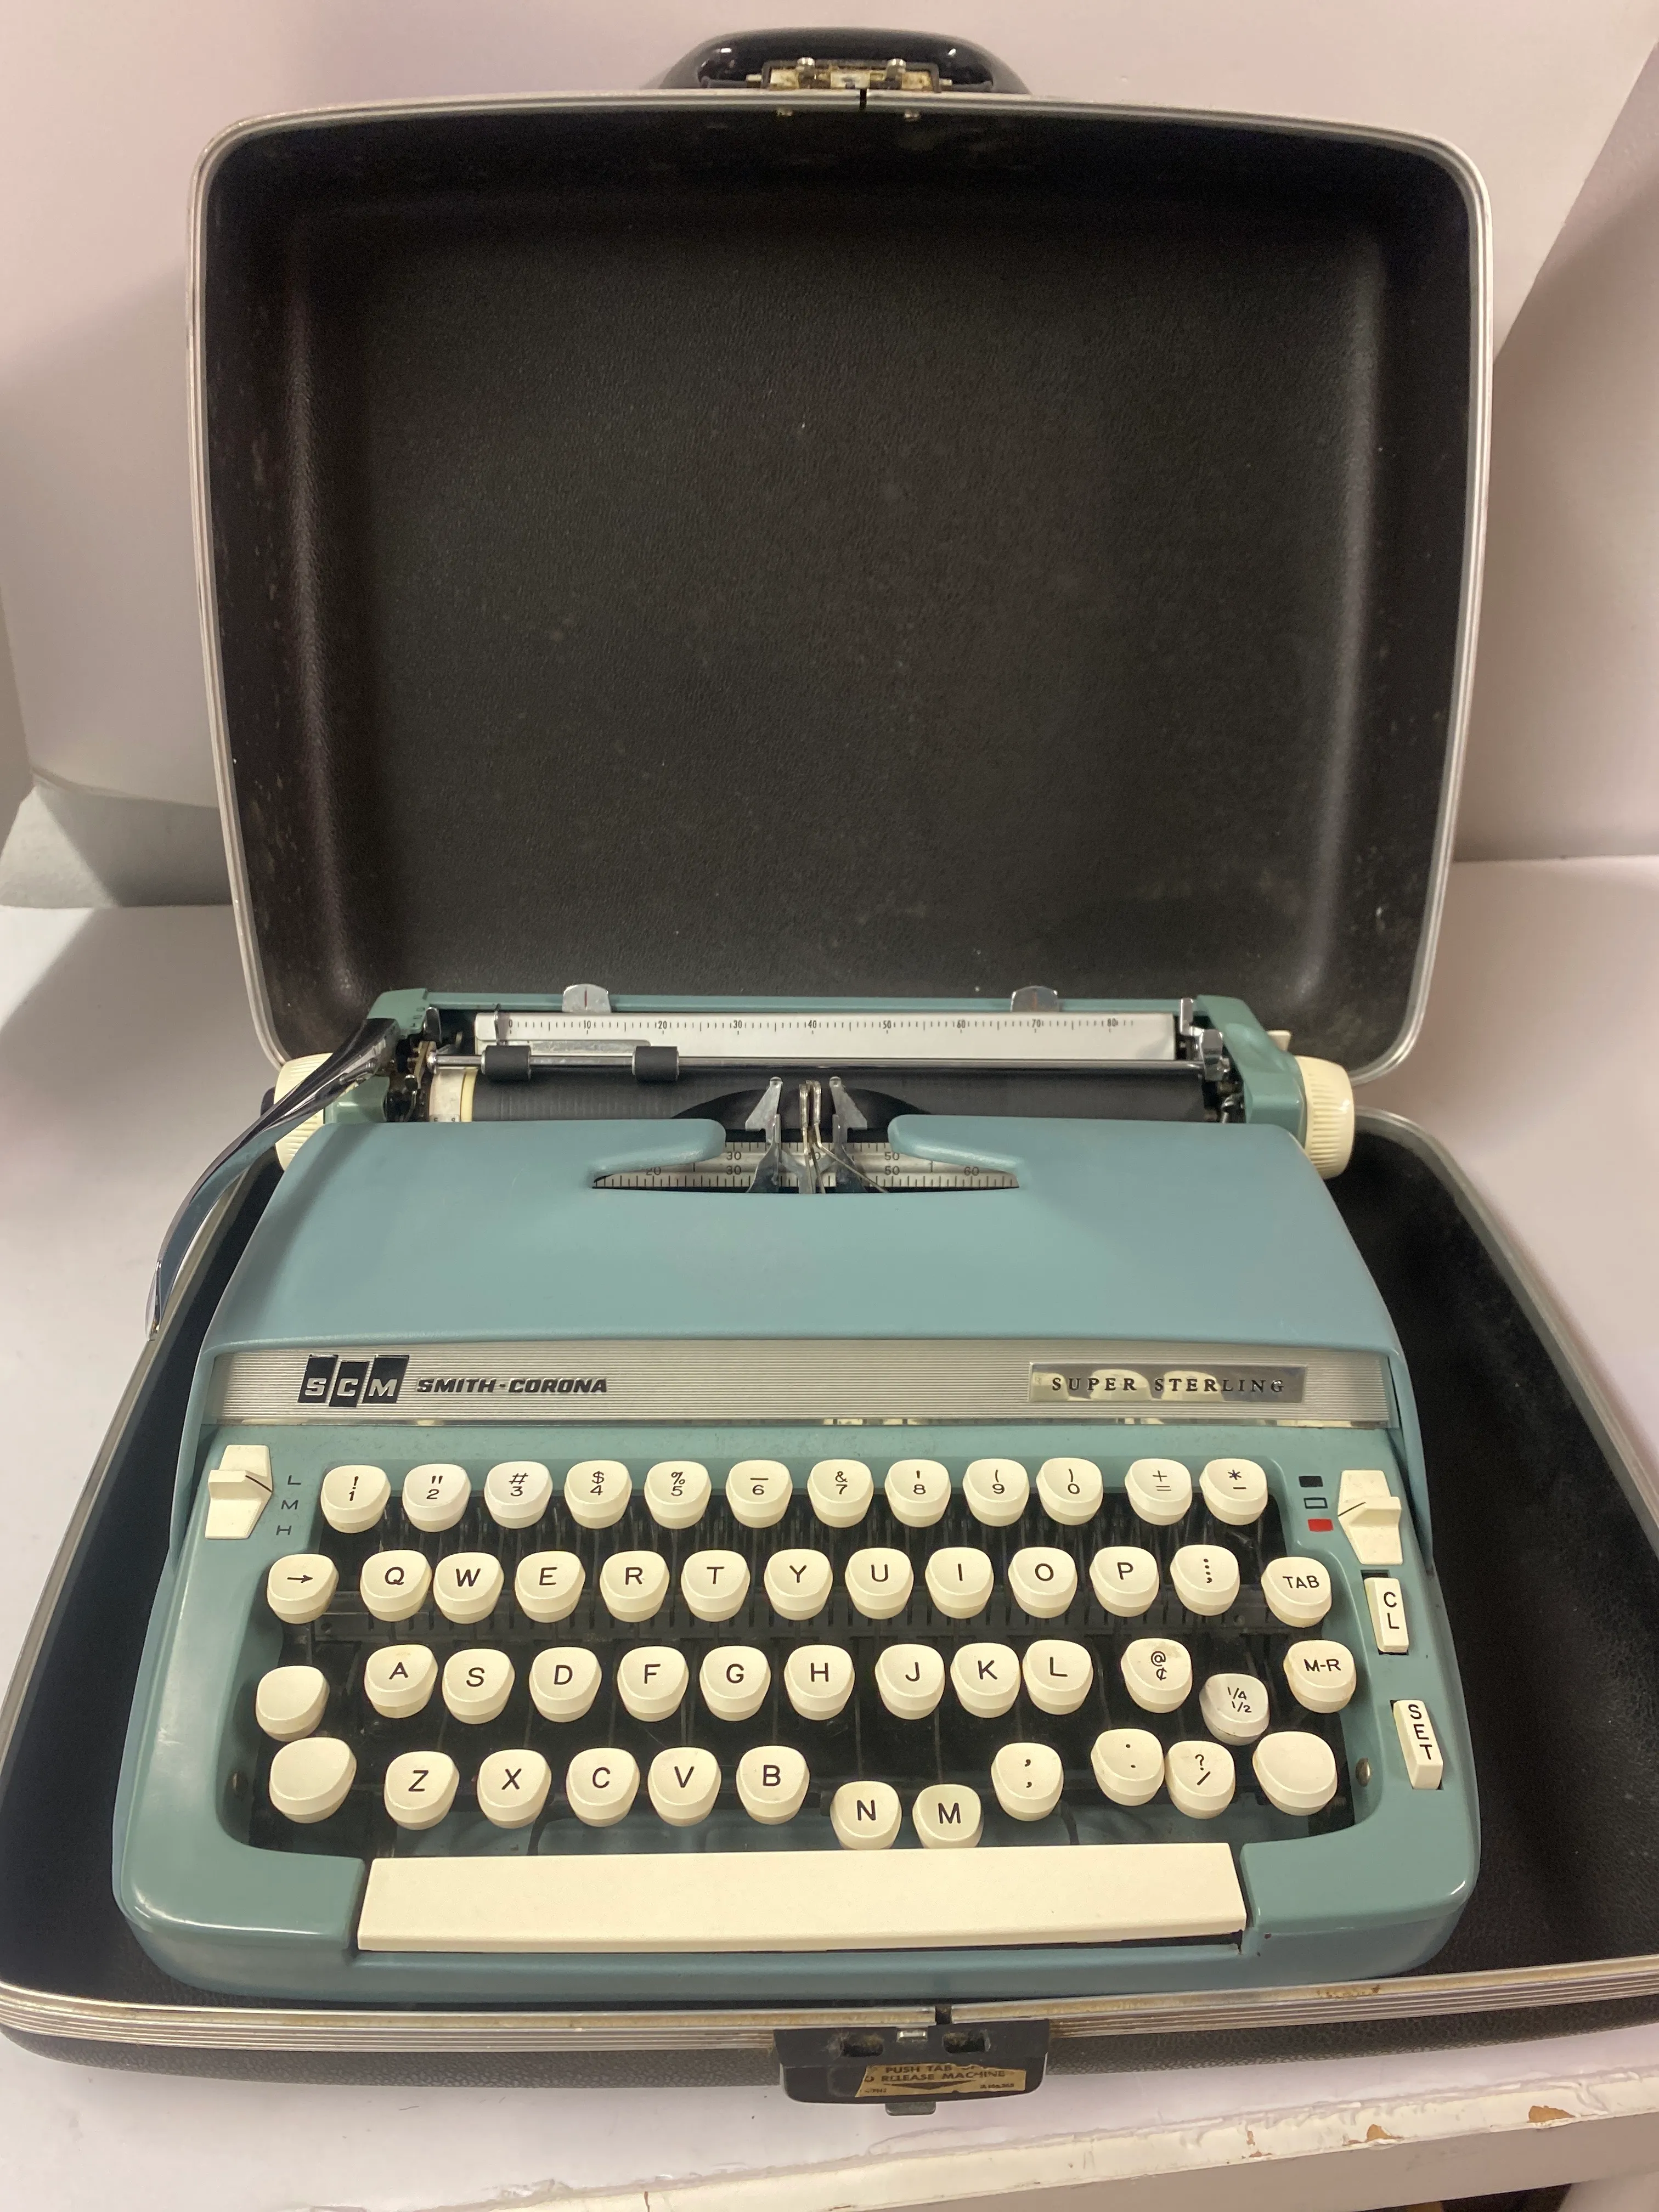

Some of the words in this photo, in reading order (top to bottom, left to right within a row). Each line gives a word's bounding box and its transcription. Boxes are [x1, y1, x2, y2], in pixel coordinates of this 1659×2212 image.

[509, 1020, 513, 1029] 0
[584, 1020, 591, 1029] 10
[658, 1021, 667, 1029] 20
[733, 1020, 742, 1029] 30
[808, 1020, 817, 1029] 40
[883, 1020, 891, 1029] 50
[957, 1020, 966, 1028] 60
[1032, 1019, 1041, 1028] 70
[1107, 1019, 1116, 1027] 80
[726, 1152, 742, 1160] 30
[808, 1152, 821, 1160] 0
[726, 1165, 741, 1175] 30
[885, 1166, 900, 1175] 50
[964, 1167, 979, 1176] 60
[304, 1378, 398, 1397] SCM
[416, 1379, 607, 1393] SMITH-CORONA
[1052, 1378, 1137, 1391] SUPER
[1155, 1378, 1284, 1393] STERLING
[287, 1475, 301, 1485] L
[992, 1482, 1005, 1494] 9
[349, 1491, 354, 1501] 1
[427, 1489, 439, 1499] 2
[511, 1486, 523, 1496] 3
[590, 1485, 603, 1495] 4
[671, 1486, 682, 1496] 5
[753, 1485, 764, 1495] 6
[836, 1485, 847, 1494] 7
[913, 1485, 926, 1494] 8
[281, 1500, 298, 1510] M
[276, 1525, 292, 1535] H
[385, 1567, 404, 1585] Q
[456, 1568, 481, 1587] W
[539, 1567, 557, 1585] E
[625, 1567, 642, 1585] R
[707, 1567, 724, 1584] T
[789, 1565, 806, 1583] Y
[871, 1564, 888, 1582] U
[958, 1564, 963, 1581] I
[1035, 1564, 1053, 1581] O
[1118, 1562, 1133, 1579] P
[1283, 1576, 1319, 1588] TAB
[389, 1662, 408, 1679] A
[645, 1664, 661, 1684] F
[726, 1664, 744, 1683] G
[811, 1663, 828, 1682] H
[905, 1662, 919, 1681] J
[978, 1660, 997, 1679] K
[1050, 1657, 1068, 1677] L
[1304, 1659, 1341, 1672] M-R
[466, 1667, 484, 1687] S
[554, 1665, 572, 1685] D
[408, 1770, 428, 1792] Z
[502, 1769, 521, 1790] X
[592, 1767, 610, 1788] C
[674, 1767, 694, 1788] V
[763, 1765, 781, 1786] B
[857, 1800, 876, 1821] N
[938, 1803, 961, 1824] M
